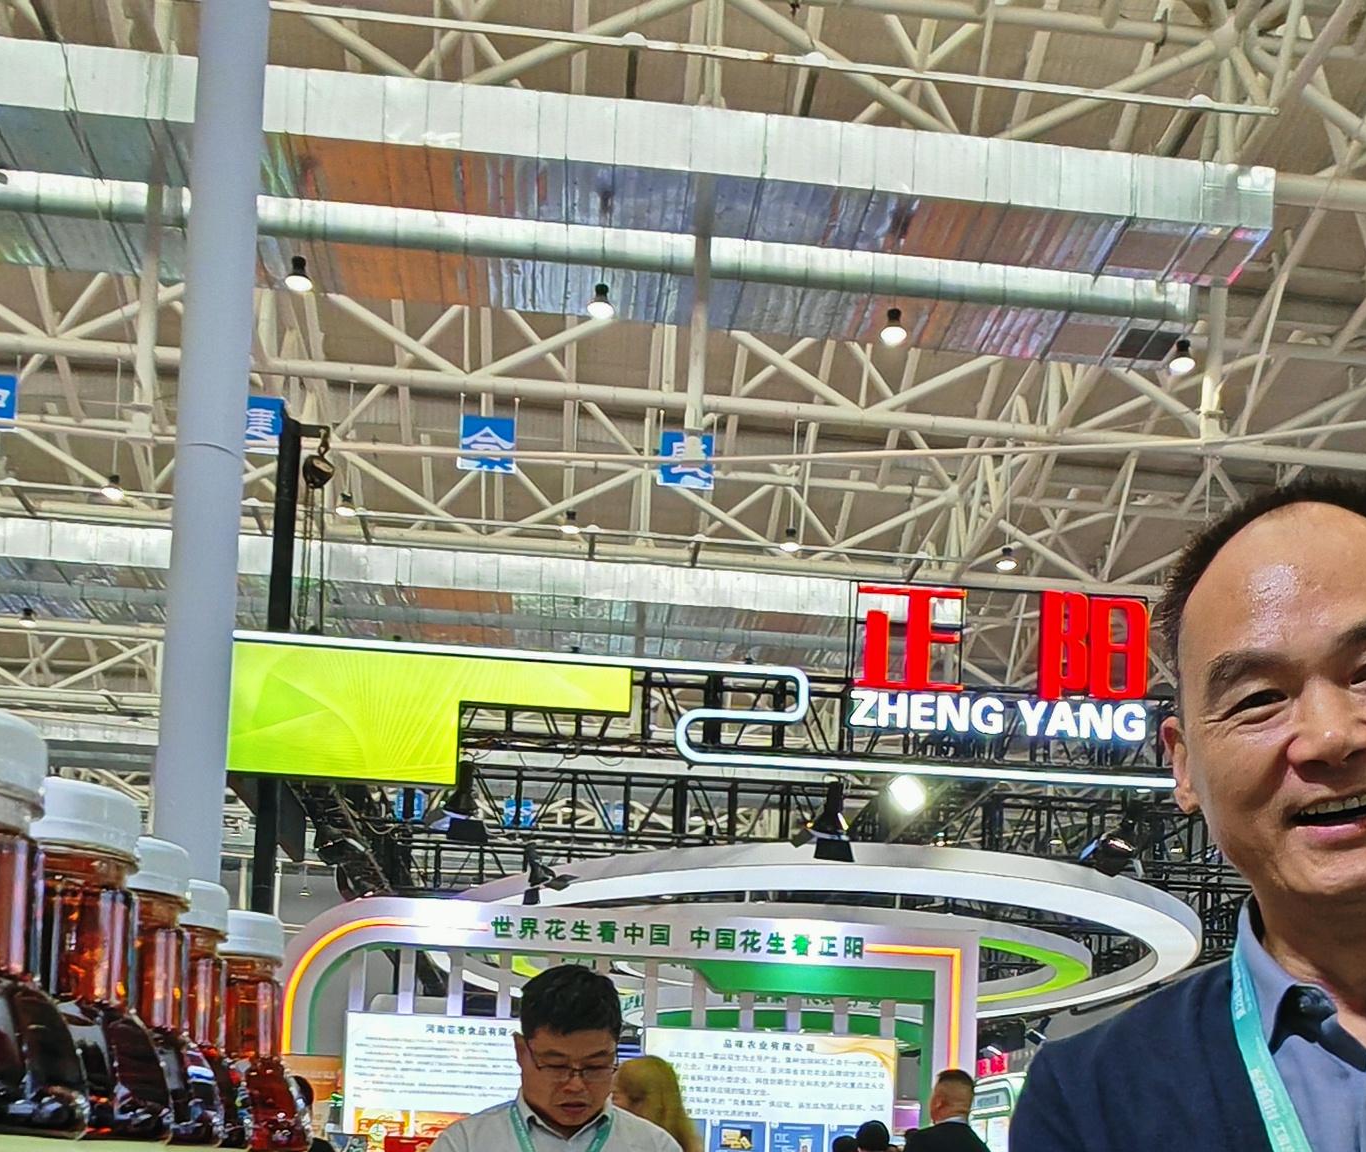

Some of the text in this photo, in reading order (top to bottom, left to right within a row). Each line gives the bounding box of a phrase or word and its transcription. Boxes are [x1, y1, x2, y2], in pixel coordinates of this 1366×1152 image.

[853, 581, 1149, 700] 正阳
[849, 690, 1148, 742] ZHENG YANG
[491, 915, 865, 959] 世界花生看中国 中国花生看正阳
